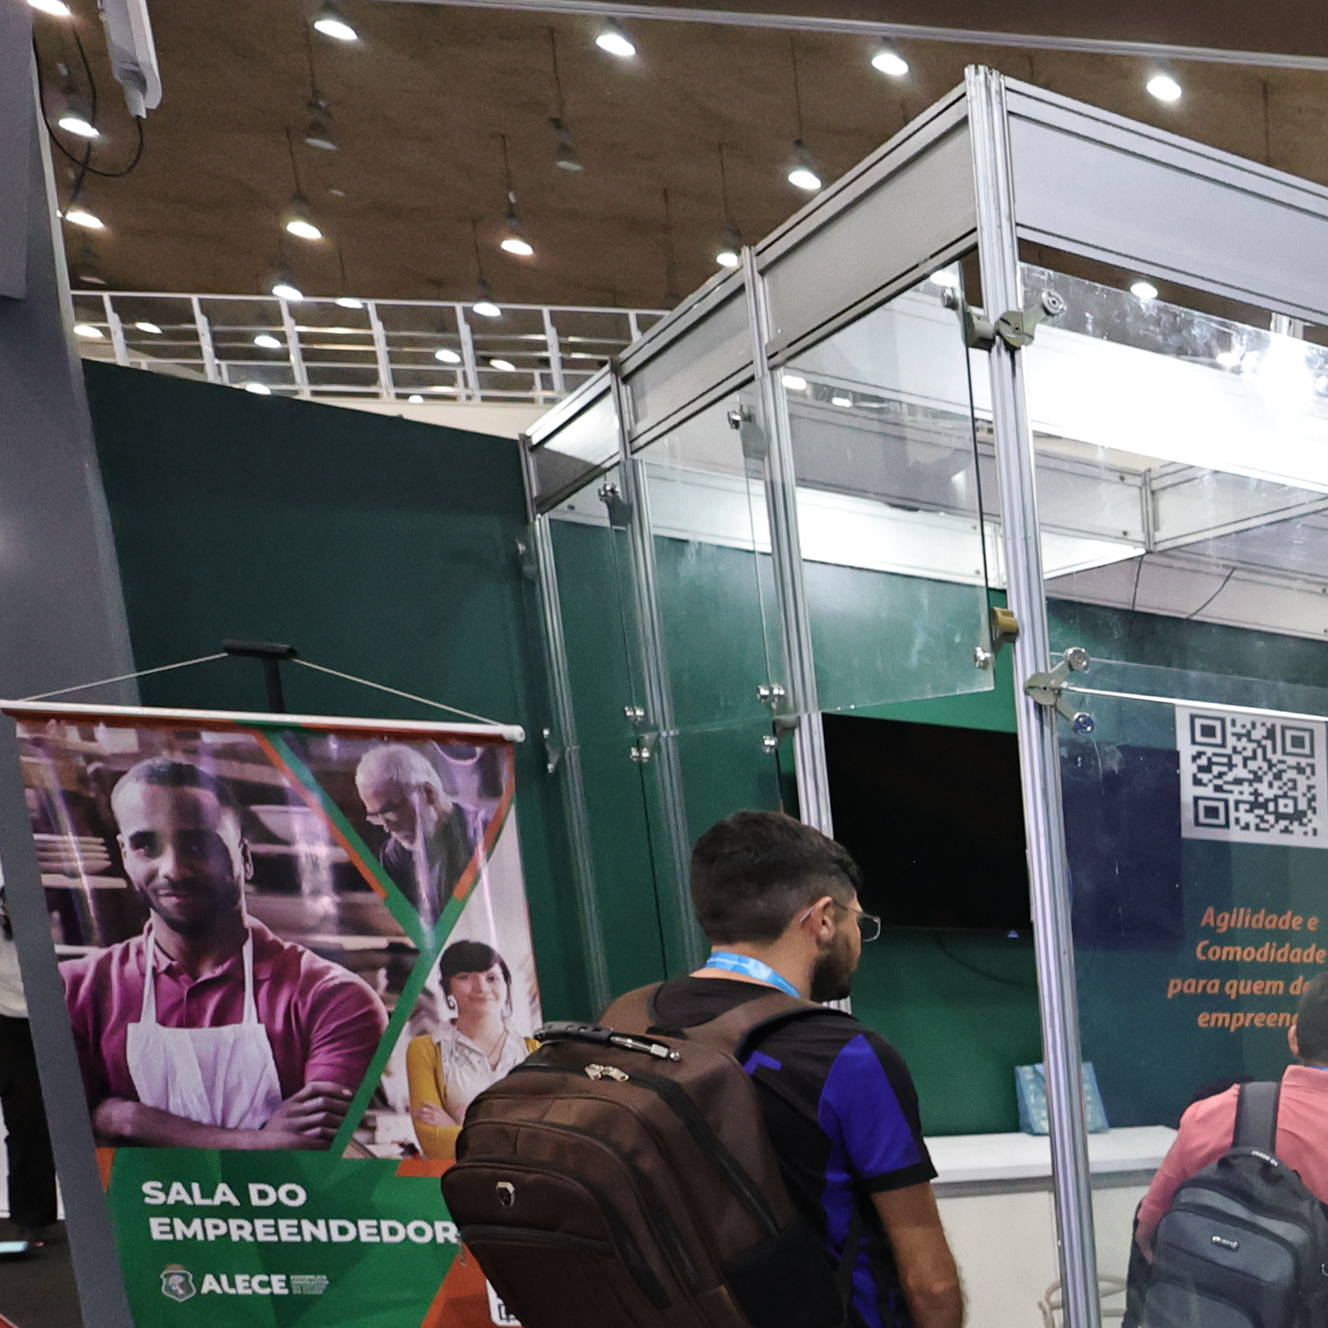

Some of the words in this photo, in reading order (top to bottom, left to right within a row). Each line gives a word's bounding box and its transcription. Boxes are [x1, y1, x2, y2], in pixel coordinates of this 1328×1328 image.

[1201, 906, 1304, 933] Agilidade
[1306, 916, 1320, 931] e
[1195, 940, 1328, 964] Comodidade
[1167, 978, 1221, 999] para
[1224, 978, 1285, 999] quem
[1197, 1012, 1299, 1032] empreen
[141, 1181, 240, 1206] SALA
[247, 1183, 307, 1207] DO
[149, 1217, 461, 1244] EMPREENDEDOR
[200, 1274, 289, 1295] ALECE
